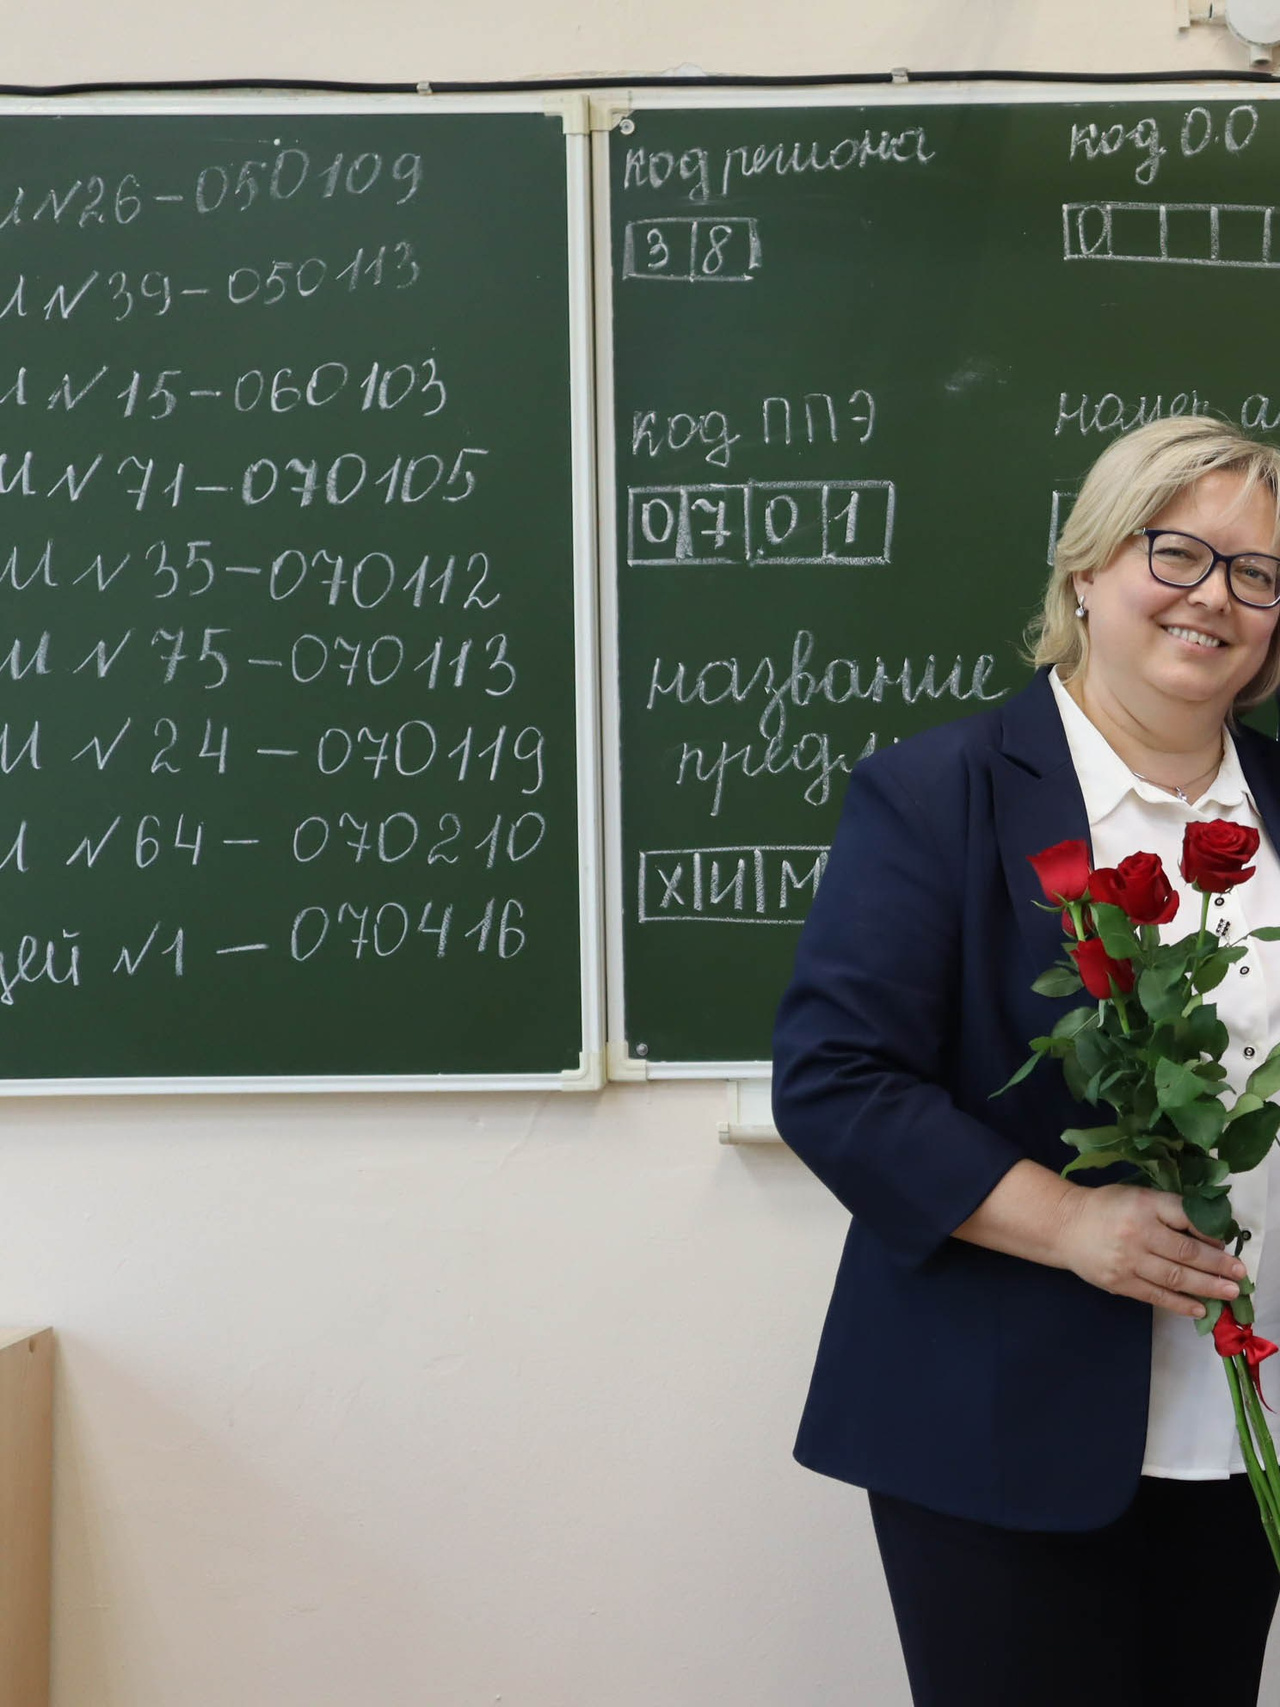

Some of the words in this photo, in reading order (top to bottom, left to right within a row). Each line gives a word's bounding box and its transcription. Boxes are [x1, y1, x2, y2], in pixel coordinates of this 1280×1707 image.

[623, 145, 715, 206] код
[1068, 117, 1168, 186] код
[631, 409, 742, 469] код
[761, 388, 877, 446] ППЭ
[674, 728, 902, 818] пред
